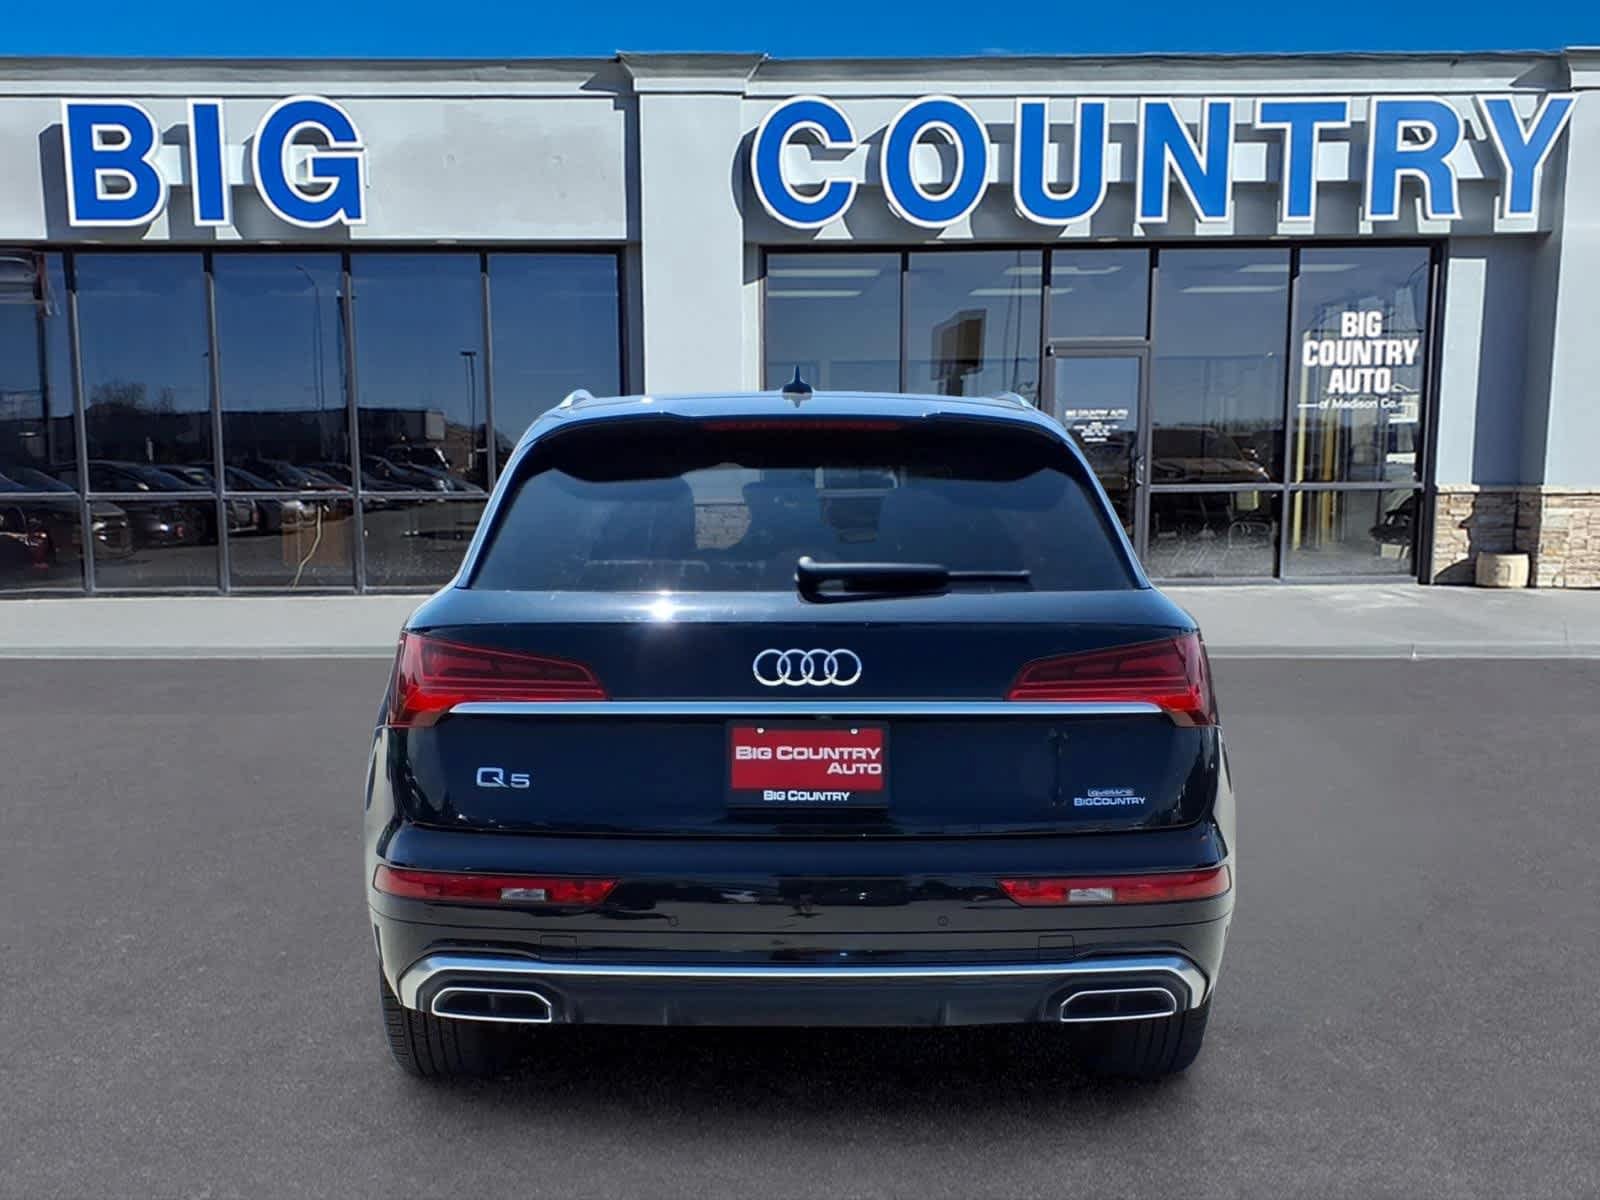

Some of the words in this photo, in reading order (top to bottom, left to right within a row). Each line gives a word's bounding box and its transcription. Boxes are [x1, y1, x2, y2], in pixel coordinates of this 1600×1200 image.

[60, 95, 367, 229] BIG
[750, 95, 1574, 229] COUNTRY
[1341, 311, 1382, 338] BIG
[1303, 339, 1419, 367] COUNTRY
[1328, 368, 1392, 394] AUTO
[1331, 399, 1378, 409] Madison
[735, 746, 772, 760] BIG
[776, 746, 881, 760] COUNTRY
[827, 762, 882, 775] AUTO
[763, 790, 786, 801] BIG
[788, 790, 850, 801] COUNTRY
